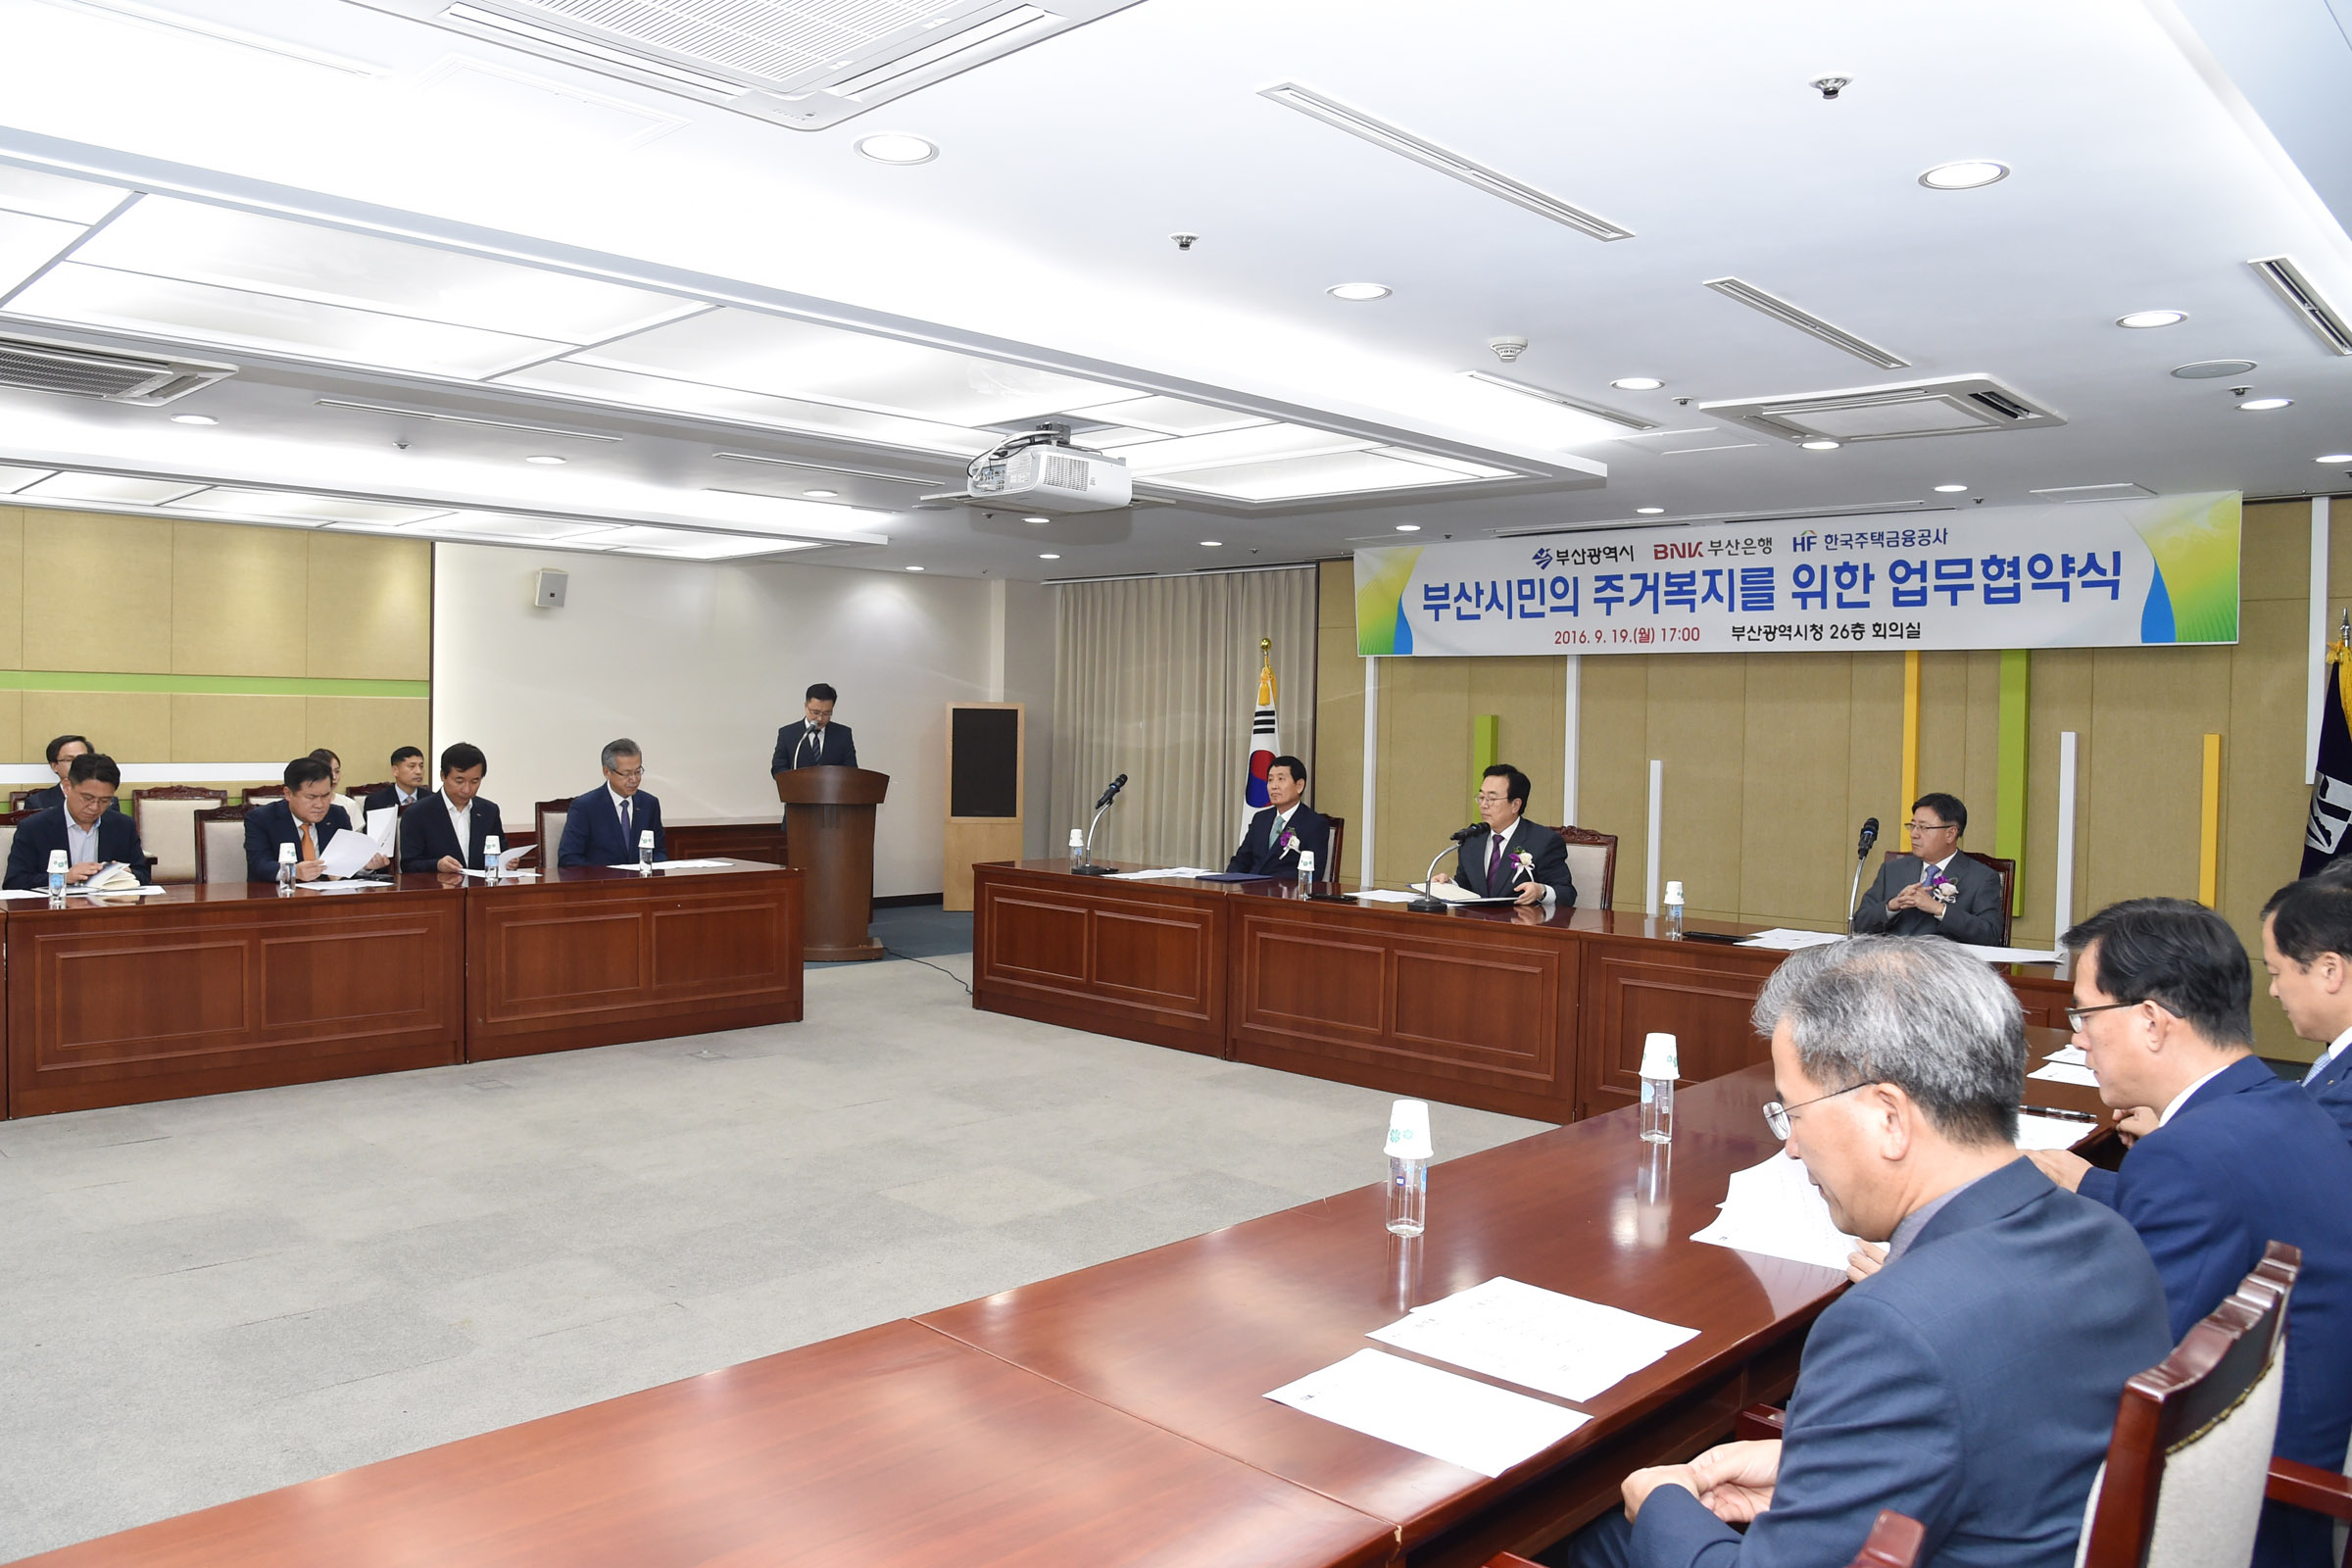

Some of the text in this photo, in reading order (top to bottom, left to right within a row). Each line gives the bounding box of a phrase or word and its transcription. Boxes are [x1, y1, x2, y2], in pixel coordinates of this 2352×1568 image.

[1653, 536, 1774, 561] BNK 부산은행
[1792, 527, 1948, 553] HF 한국주택금융공사
[1554, 544, 1635, 565] 부산광역시
[1423, 551, 2121, 621] 부산시민의 주거복지를 위한 업무협약식
[1554, 627, 1700, 645] 2016. 9. 19.(월) 17:00
[1732, 621, 1922, 642] 부산광역시청 26층 회의실
